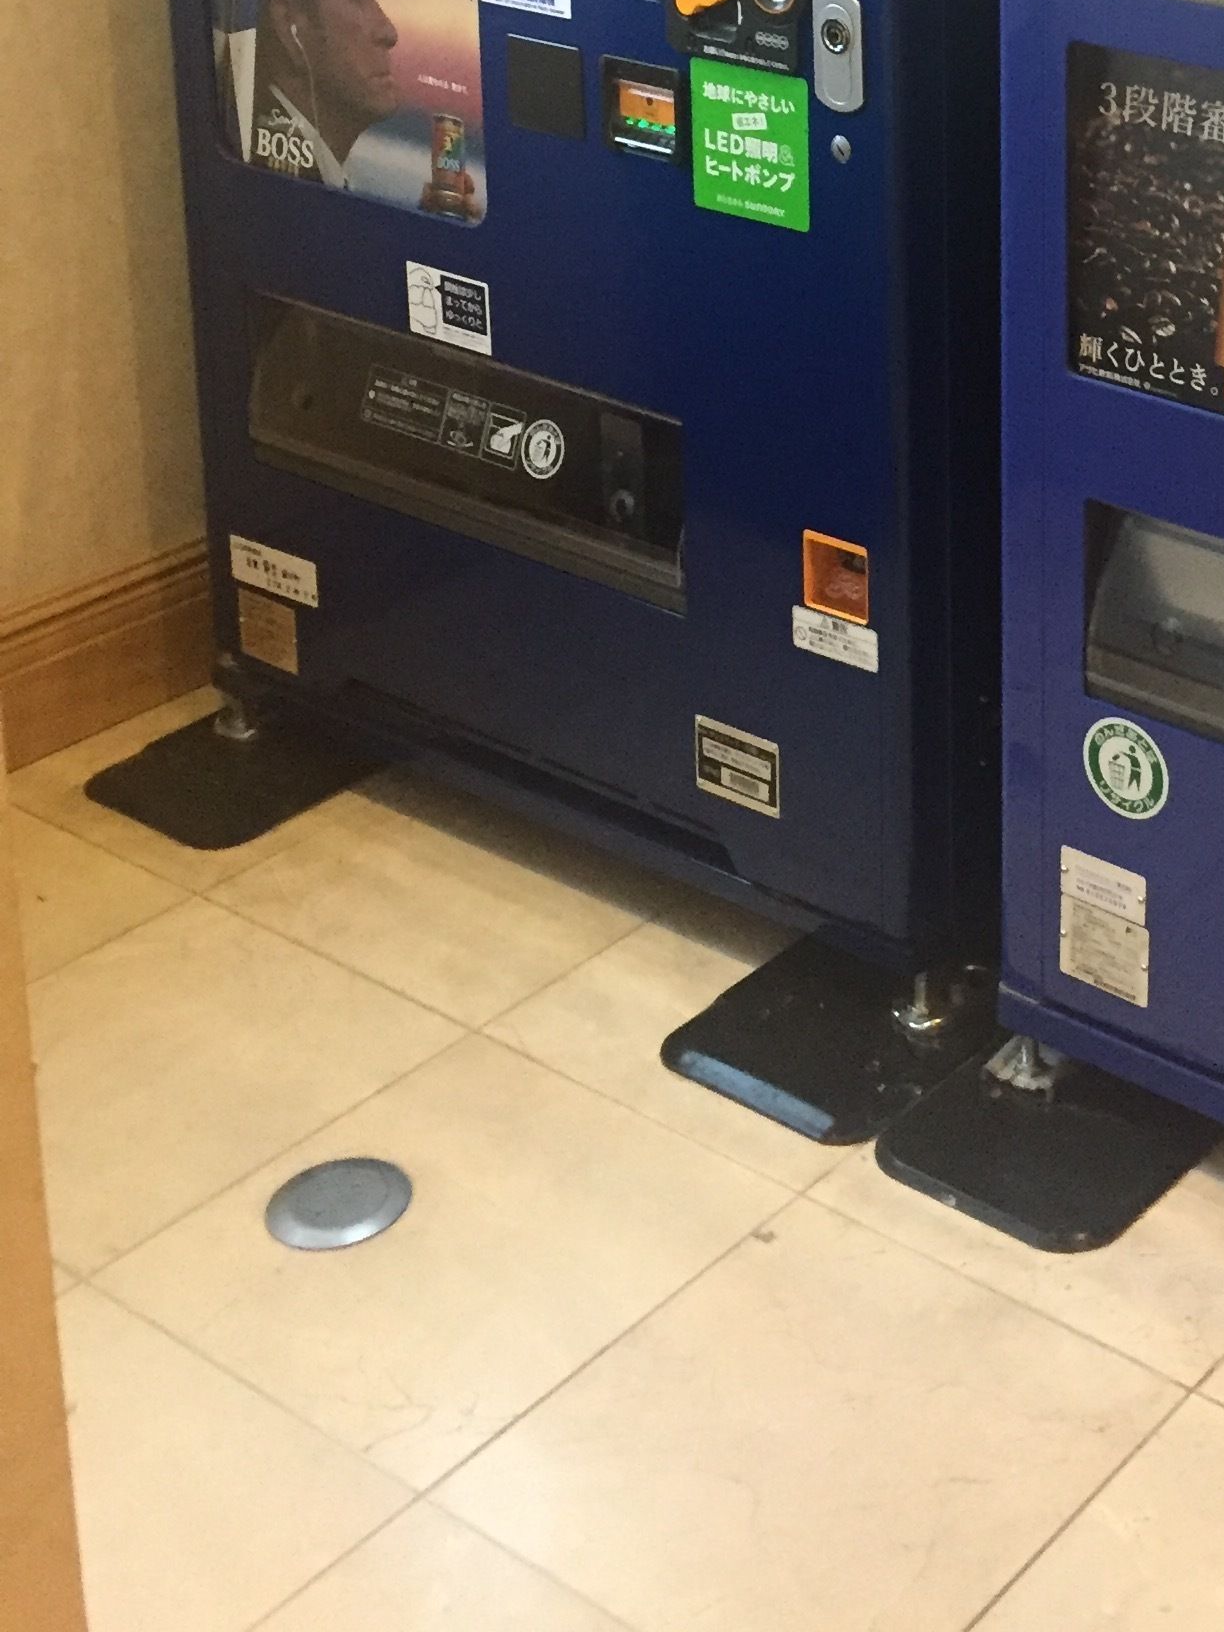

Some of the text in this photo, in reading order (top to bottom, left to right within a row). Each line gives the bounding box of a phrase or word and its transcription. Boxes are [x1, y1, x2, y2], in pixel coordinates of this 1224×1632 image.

[701, 79, 796, 115] 地球にやさしい
[256, 127, 314, 169] BOSS
[704, 153, 796, 193] ヒートポンプ
[1078, 333, 1220, 398] 輝くひととき。
